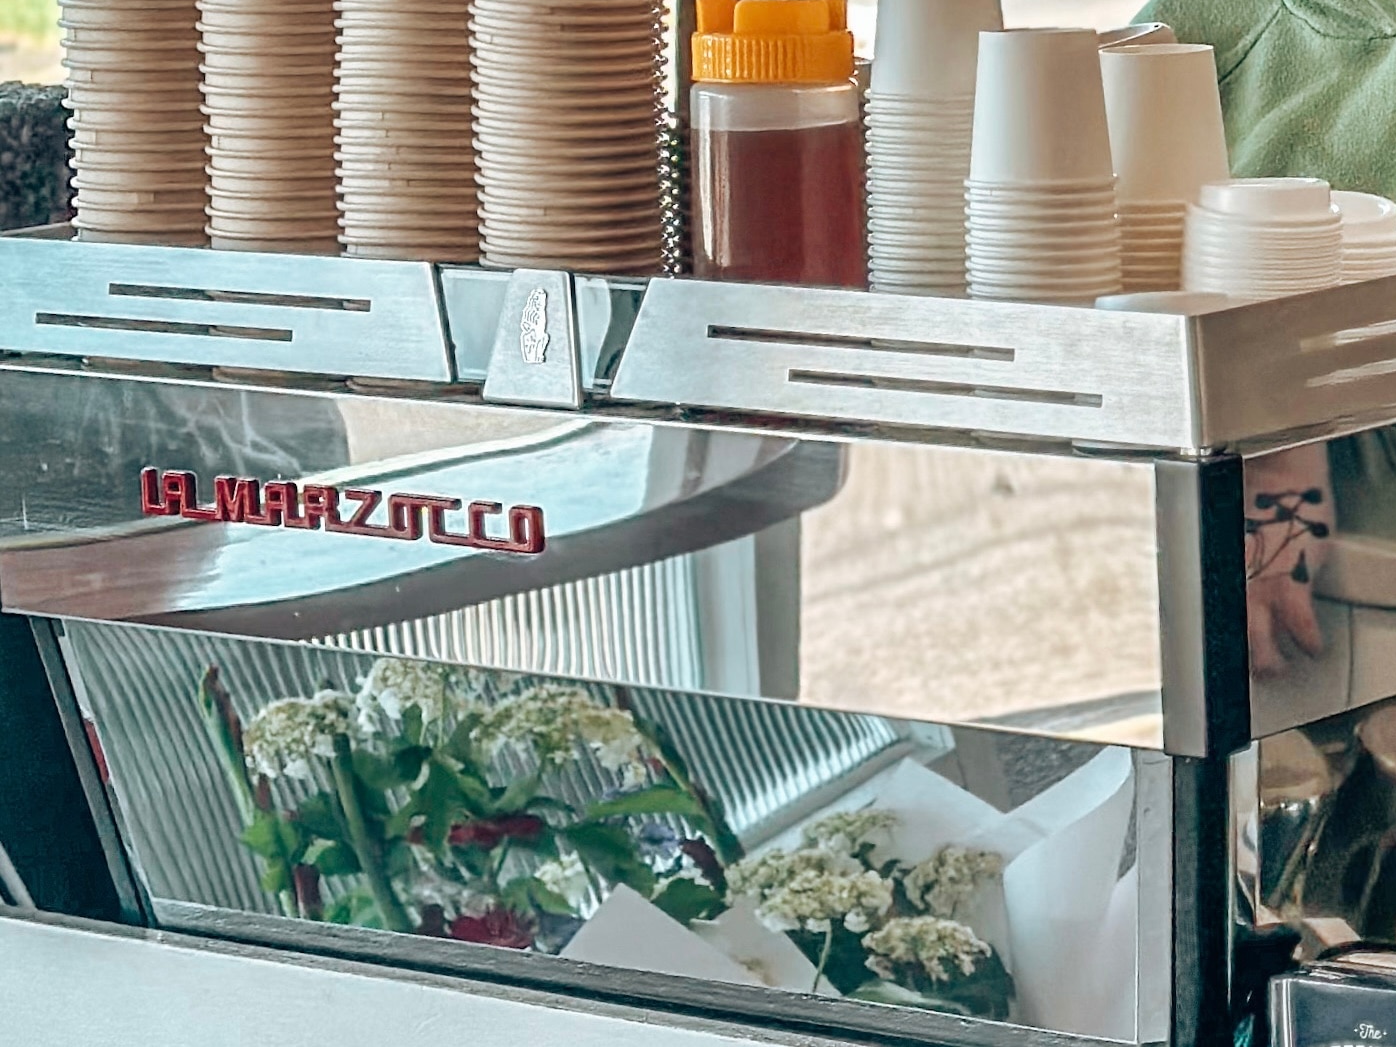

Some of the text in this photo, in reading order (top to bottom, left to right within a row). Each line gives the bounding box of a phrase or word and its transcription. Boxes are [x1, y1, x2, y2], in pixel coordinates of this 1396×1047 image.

[140, 466, 546, 554] LA MARZOCCO
[1359, 1023, 1382, 1040] The
